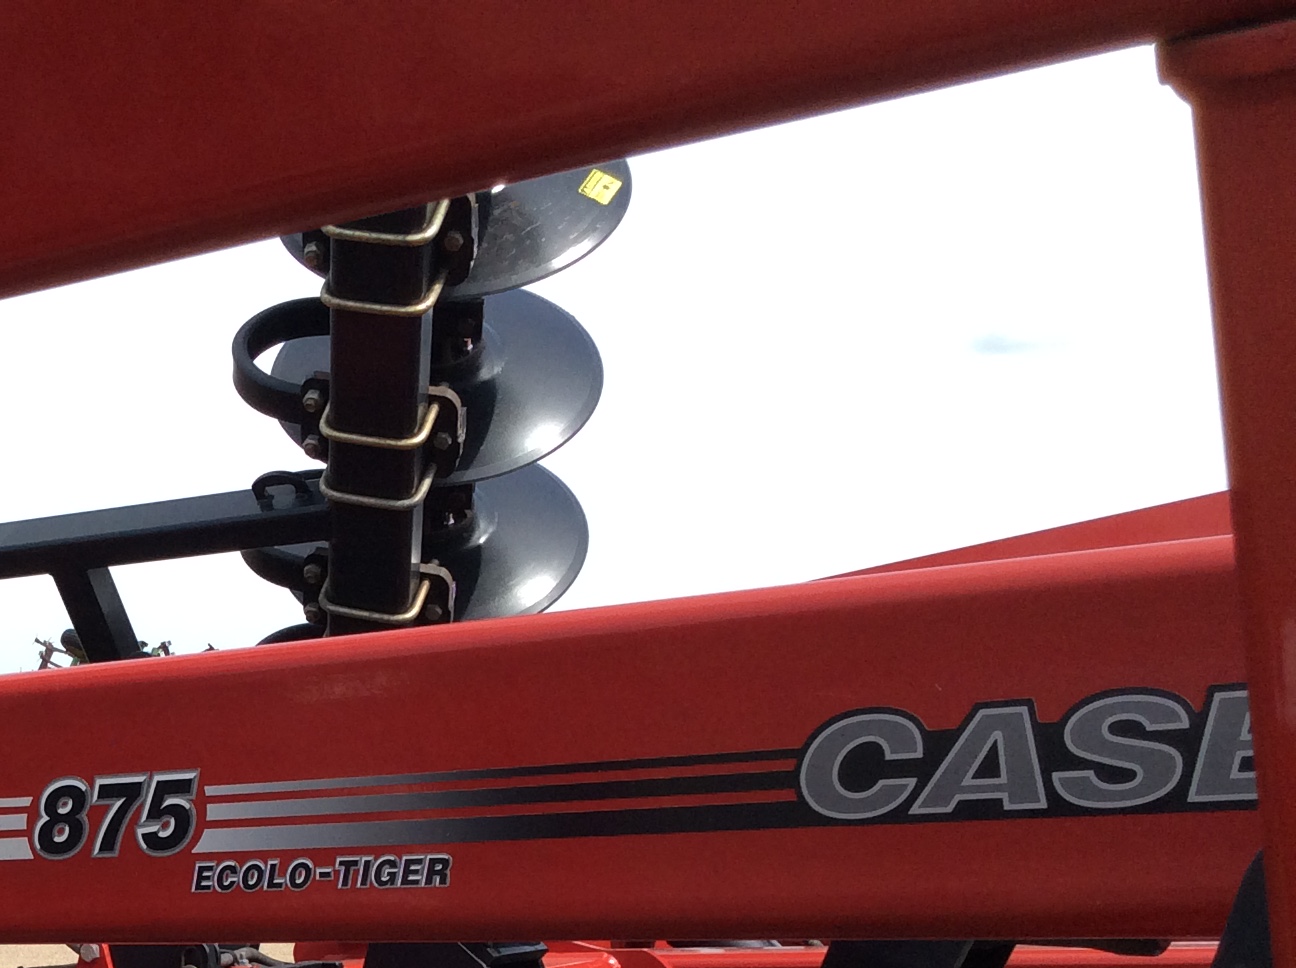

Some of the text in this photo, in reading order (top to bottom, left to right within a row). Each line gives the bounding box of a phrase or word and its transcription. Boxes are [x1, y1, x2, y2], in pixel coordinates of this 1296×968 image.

[800, 688, 1258, 820] CASE
[33, 768, 201, 859] 875
[192, 853, 453, 893] ECOLO-TIGER
